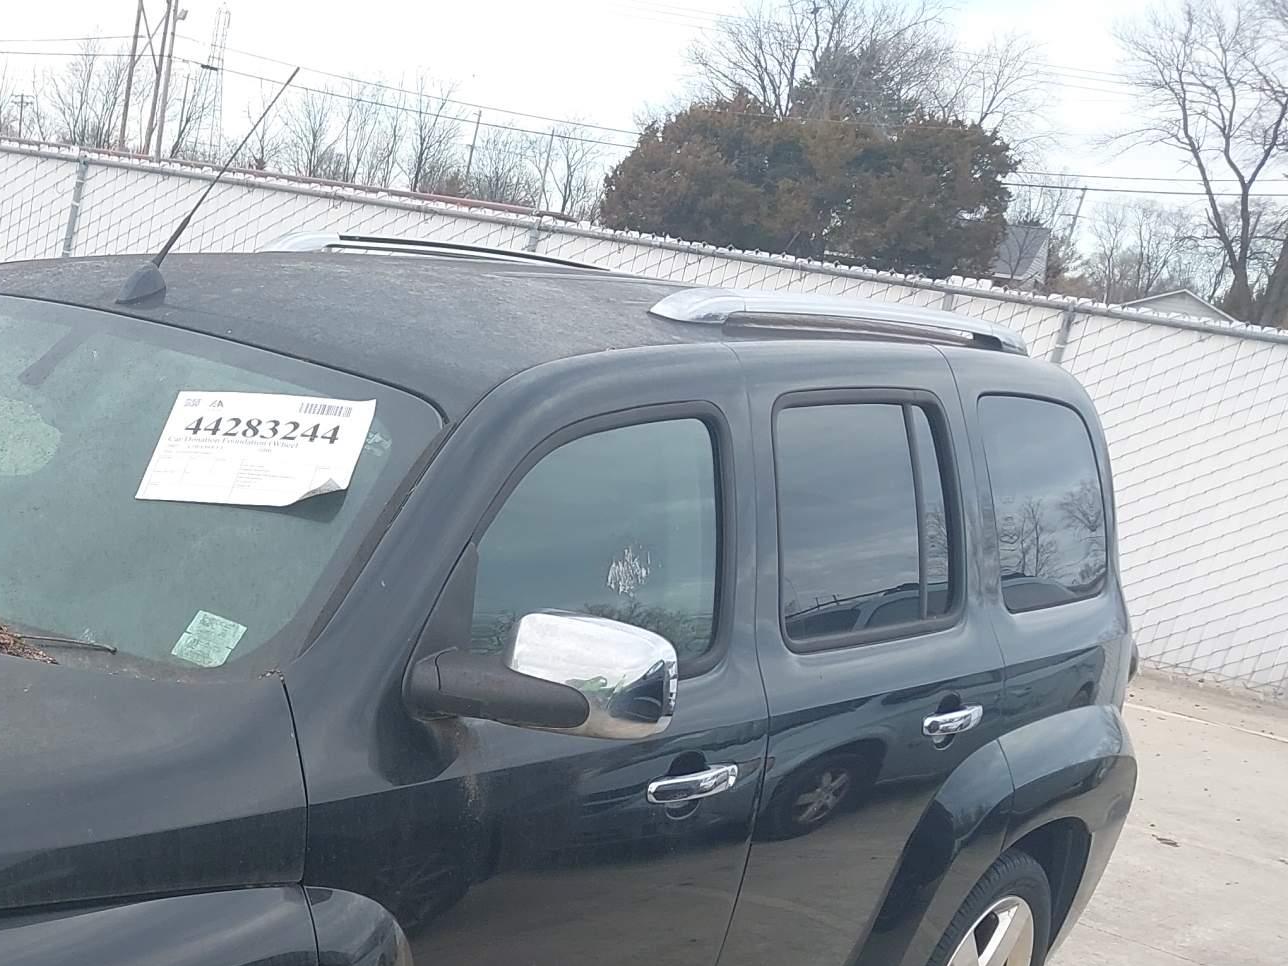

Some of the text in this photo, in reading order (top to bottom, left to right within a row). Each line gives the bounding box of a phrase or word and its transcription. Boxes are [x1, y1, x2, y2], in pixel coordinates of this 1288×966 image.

[184, 415, 341, 445] 44283244
[184, 436, 220, 445] Donation
[222, 437, 266, 447] Foundation
